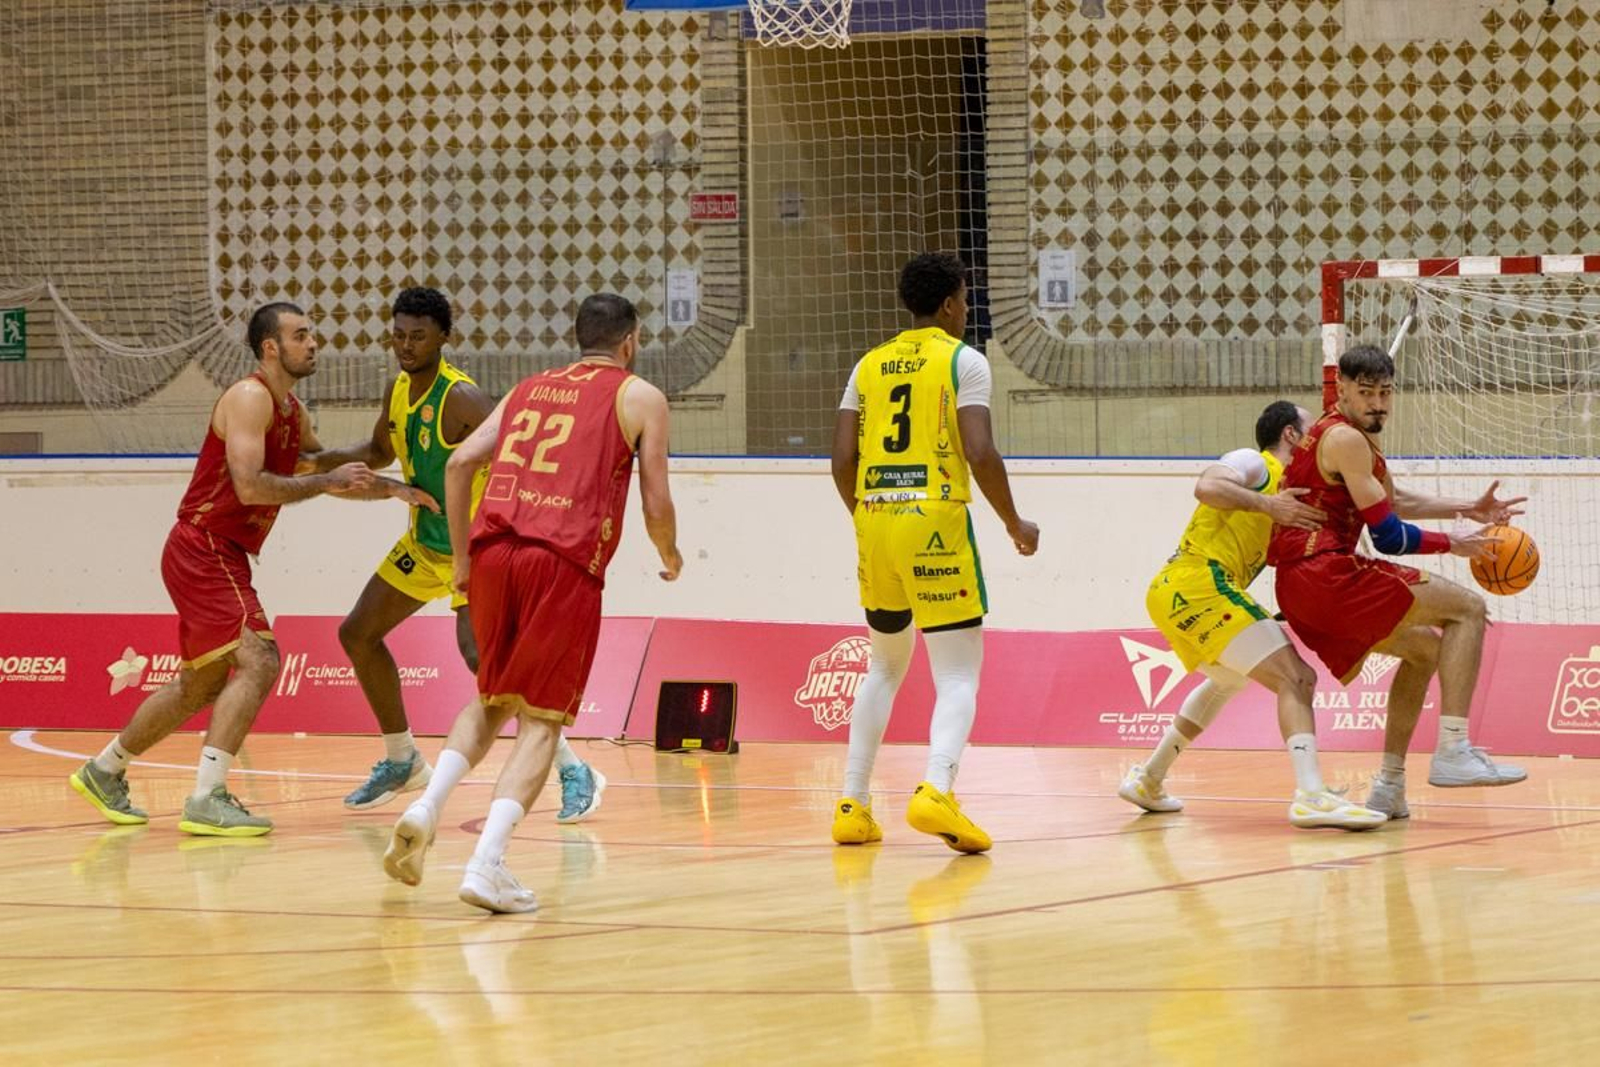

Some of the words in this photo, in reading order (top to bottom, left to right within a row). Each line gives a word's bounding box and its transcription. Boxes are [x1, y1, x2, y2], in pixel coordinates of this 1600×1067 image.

[692, 201, 705, 214] SIN
[707, 201, 736, 214] SALIDA
[883, 383, 912, 453] 3
[497, 408, 575, 474] 22
[540, 495, 573, 509] ACM
[913, 565, 960, 577] Blanca
[917, 591, 957, 603] cajasur
[152, 655, 182, 671] VIV
[146, 672, 173, 683] LUIS
[305, 663, 356, 678] CLÍNICA
[397, 667, 439, 678] ONCIA
[1312, 691, 1350, 709] AJA
[1358, 691, 1434, 709] RUL
[1099, 712, 1176, 723] CUPR
[1332, 710, 1387, 730] JAÉN
